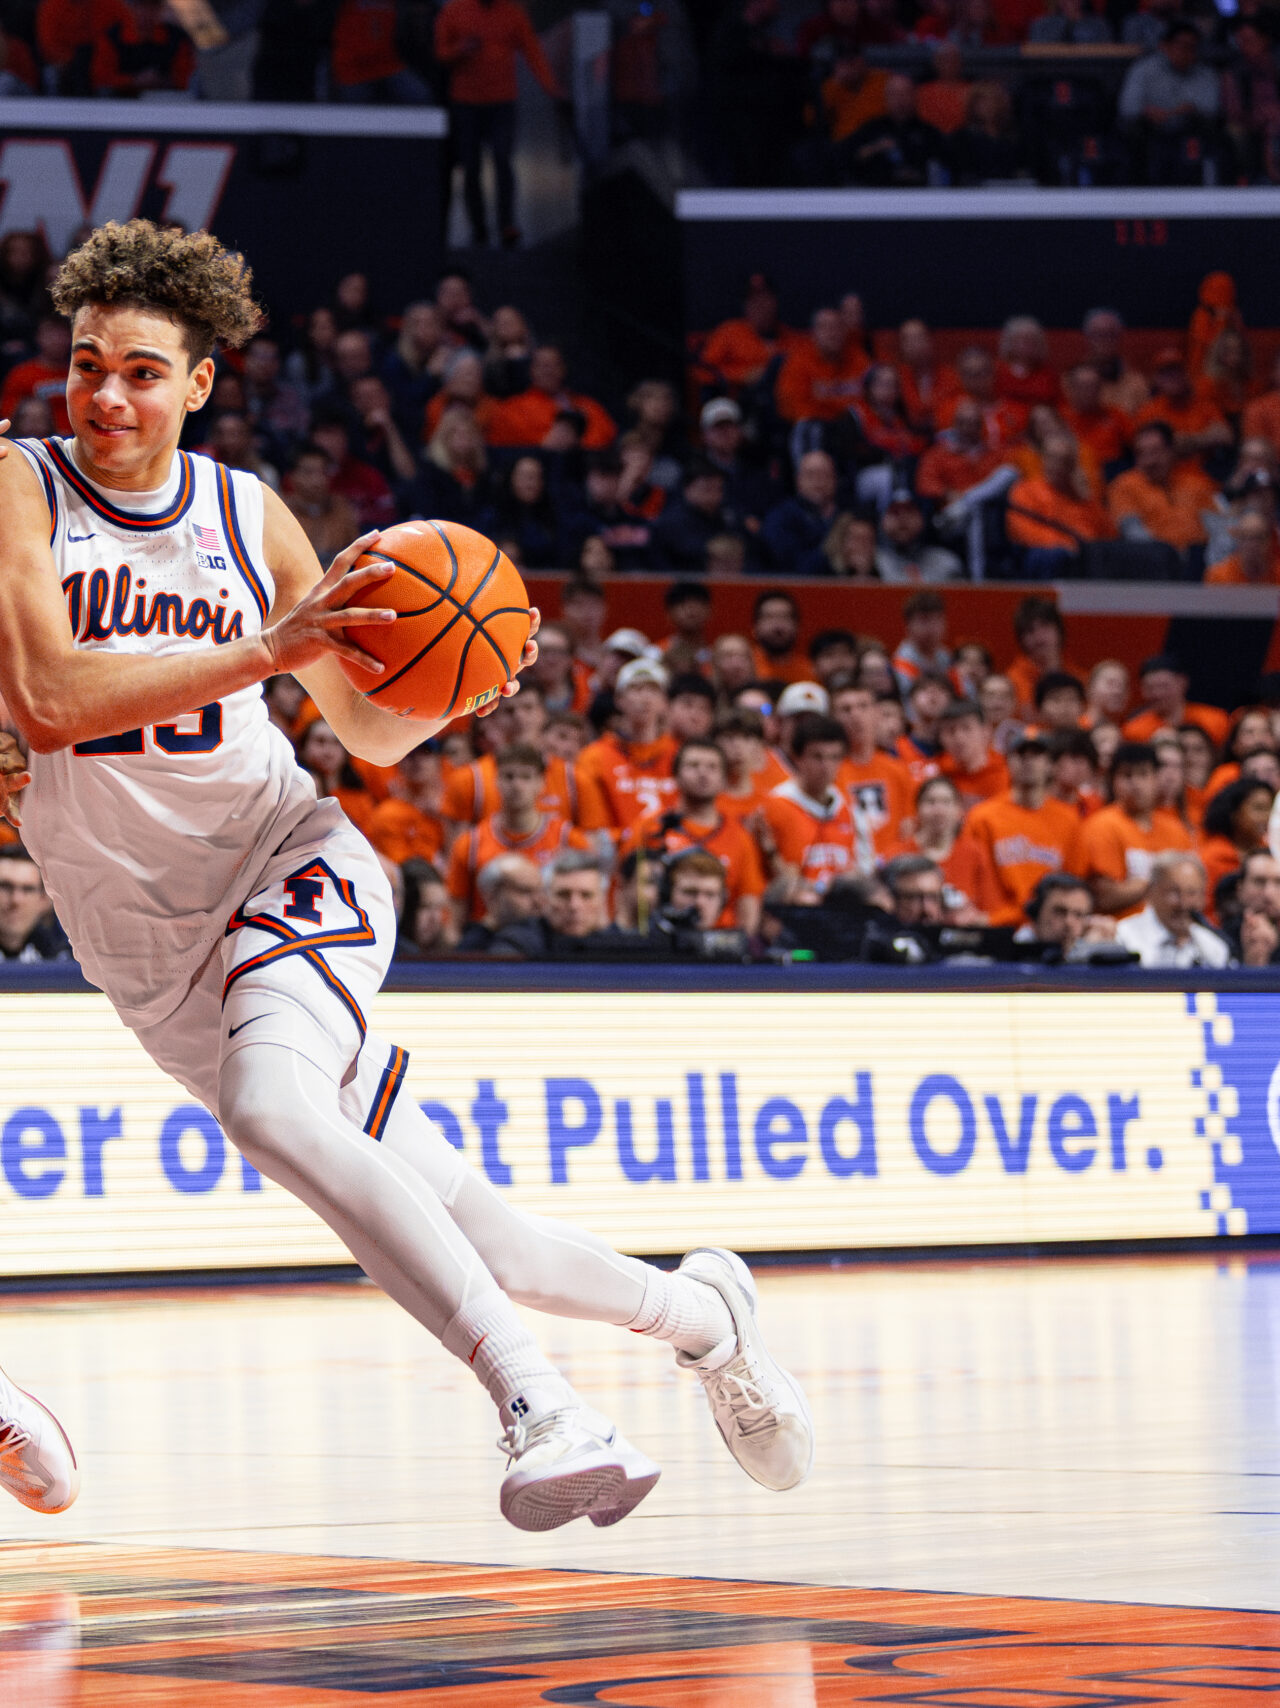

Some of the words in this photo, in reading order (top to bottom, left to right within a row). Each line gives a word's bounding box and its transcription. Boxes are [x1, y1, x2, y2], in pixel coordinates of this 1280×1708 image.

[61, 563, 244, 646] Illinois
[545, 1069, 878, 1185] Pulled
[910, 1073, 1164, 1177] Over.
